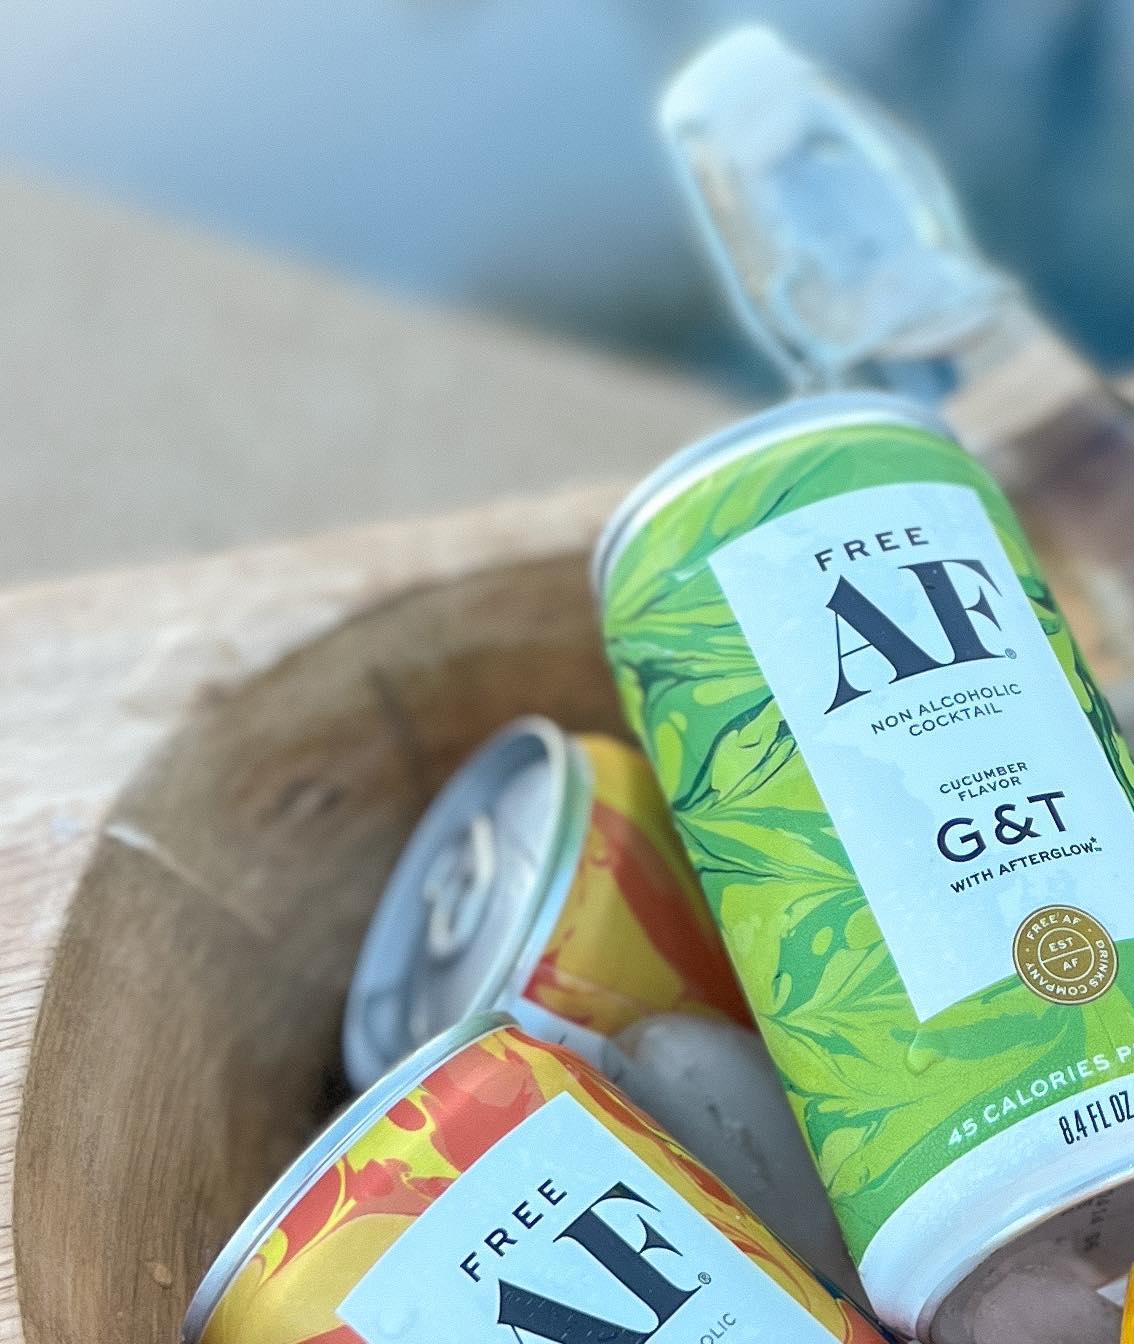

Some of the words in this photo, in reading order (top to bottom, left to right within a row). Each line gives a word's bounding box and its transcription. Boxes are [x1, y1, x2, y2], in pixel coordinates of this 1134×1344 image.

[815, 527, 929, 571] FREE
[871, 708, 912, 734] NON
[918, 683, 1022, 717] ALCOHOLIC
[909, 702, 1003, 737] COCKTAIL
[939, 761, 1028, 794] CUCUMBER
[958, 776, 1022, 801] FLAVOR
[936, 790, 1067, 863] G&T
[950, 868, 994, 894] WITH
[1026, 914, 1058, 940] FREE
[1062, 914, 1081, 926] AF
[1048, 936, 1074, 953] EST
[1025, 961, 1089, 996] COMPANY
[1063, 957, 1079, 972] AF
[1088, 939, 1110, 988] DRINKS
[948, 1118, 979, 1147] 45
[983, 1053, 1111, 1124] CALORIES
[1058, 1109, 1089, 1146] 8.4
[1087, 1100, 1113, 1133] FL
[460, 1178, 568, 1283] FREE
